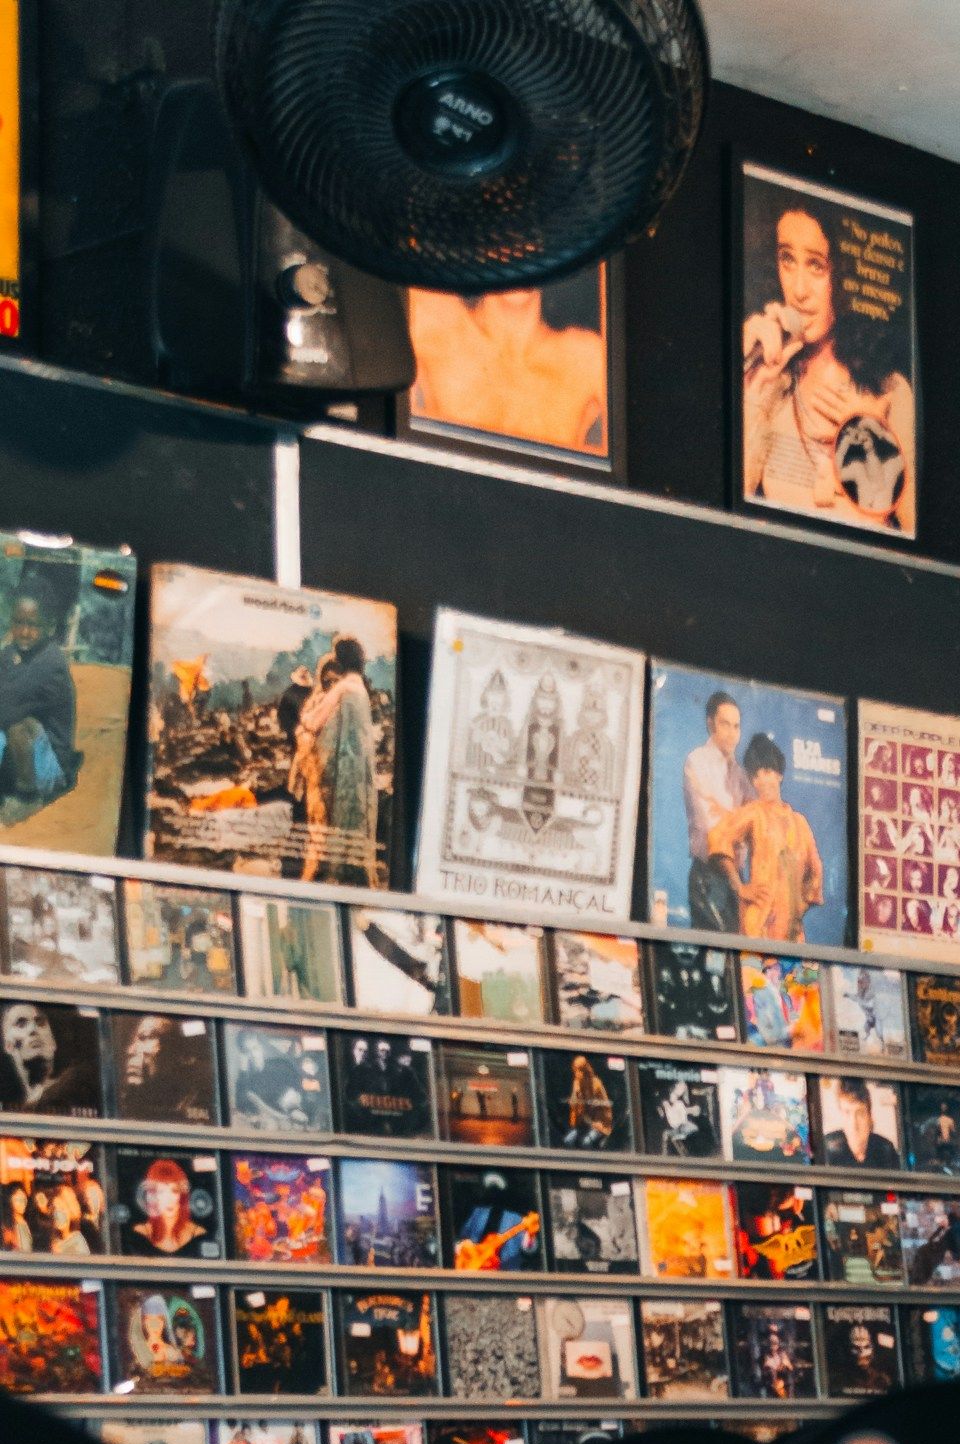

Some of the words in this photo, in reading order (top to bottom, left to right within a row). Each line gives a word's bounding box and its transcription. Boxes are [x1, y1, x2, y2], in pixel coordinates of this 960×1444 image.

[439, 92, 493, 126] ARNO
[439, 869, 488, 896] TRIO
[493, 877, 614, 915] ROMANÇAL
